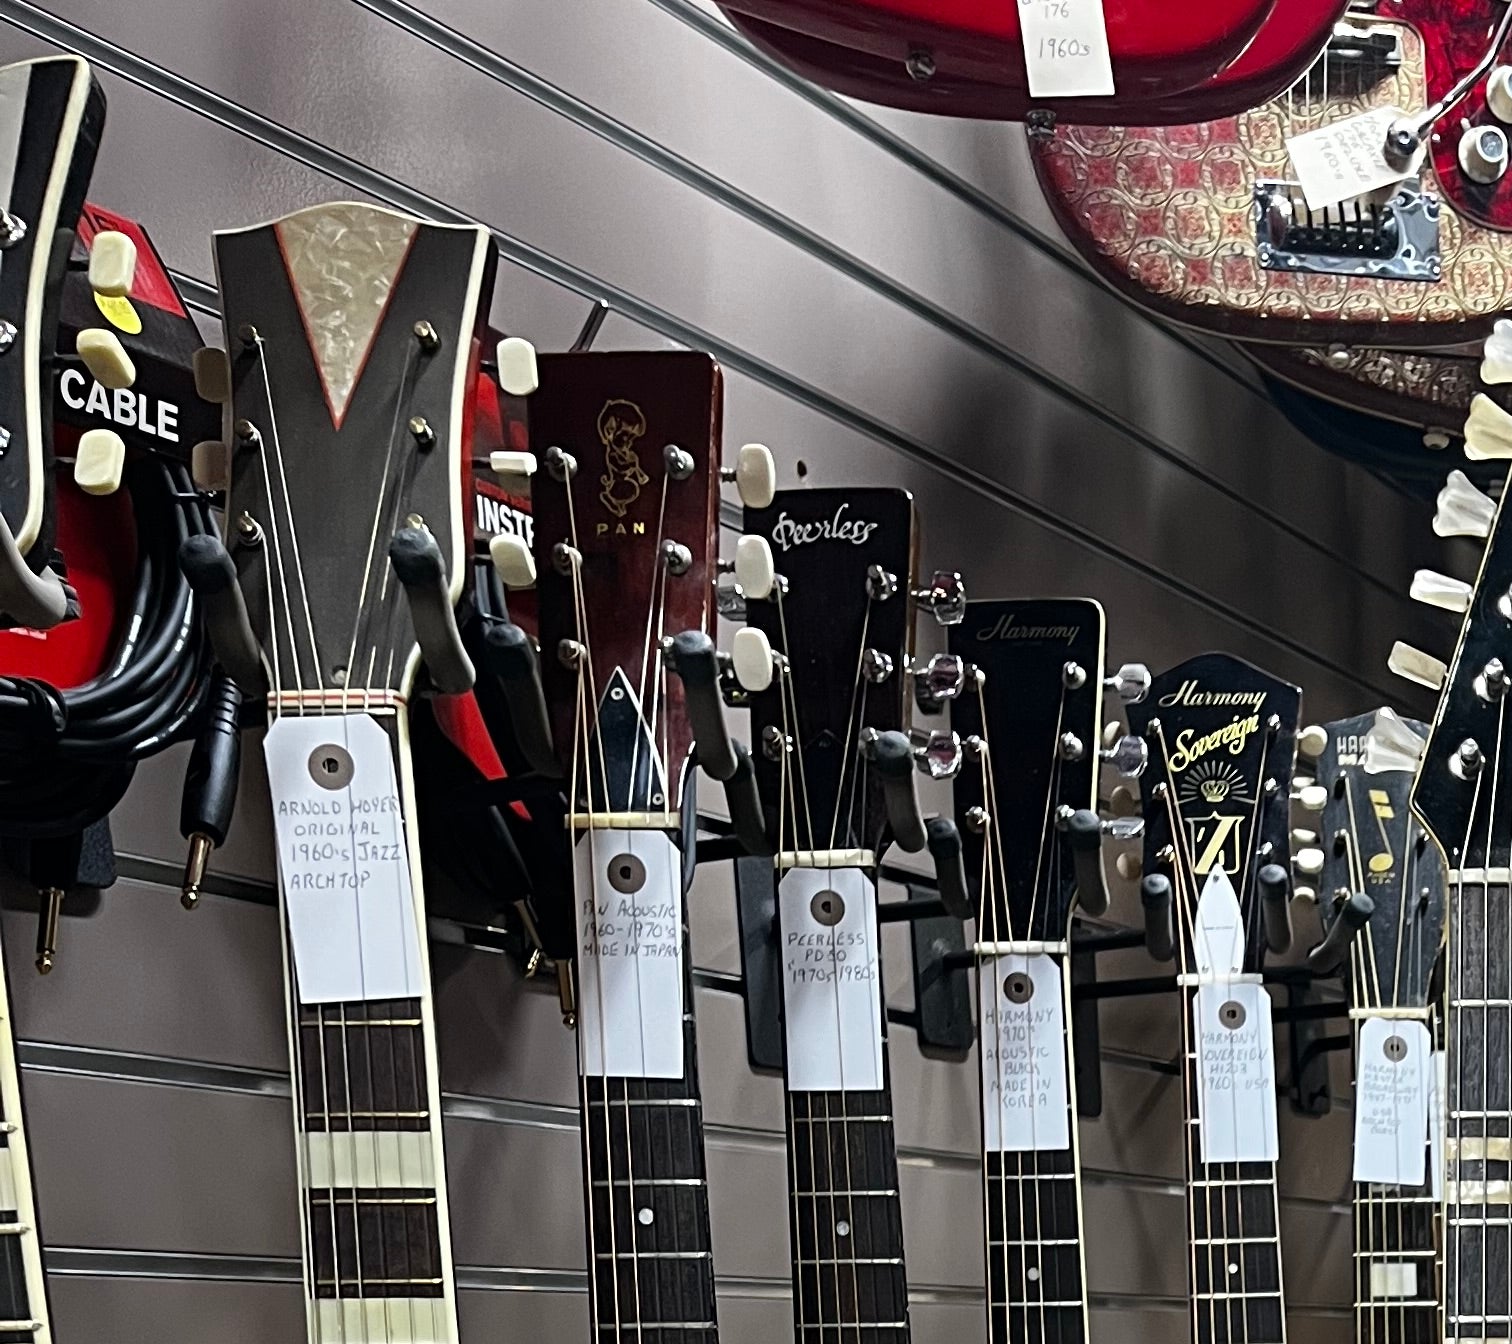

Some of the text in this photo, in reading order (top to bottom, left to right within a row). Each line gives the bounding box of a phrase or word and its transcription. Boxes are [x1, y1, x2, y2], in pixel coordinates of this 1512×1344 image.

[1044, 1, 1069, 19] 176
[60, 368, 180, 443] CABLE
[596, 521, 646, 535] PAN
[771, 502, 878, 552] Peerless
[976, 613, 1080, 647] Harmony
[1158, 679, 1267, 713] Harmony
[1168, 713, 1260, 772] Sovereign
[278, 794, 400, 816] ARNOLD HOYER
[294, 820, 380, 837] ORIGINAL
[356, 841, 402, 862] JAZZ
[786, 931, 866, 947] PEERLESS
[642, 943, 683, 958] JAPAN
[986, 1046, 1049, 1061] AOUSTIC
